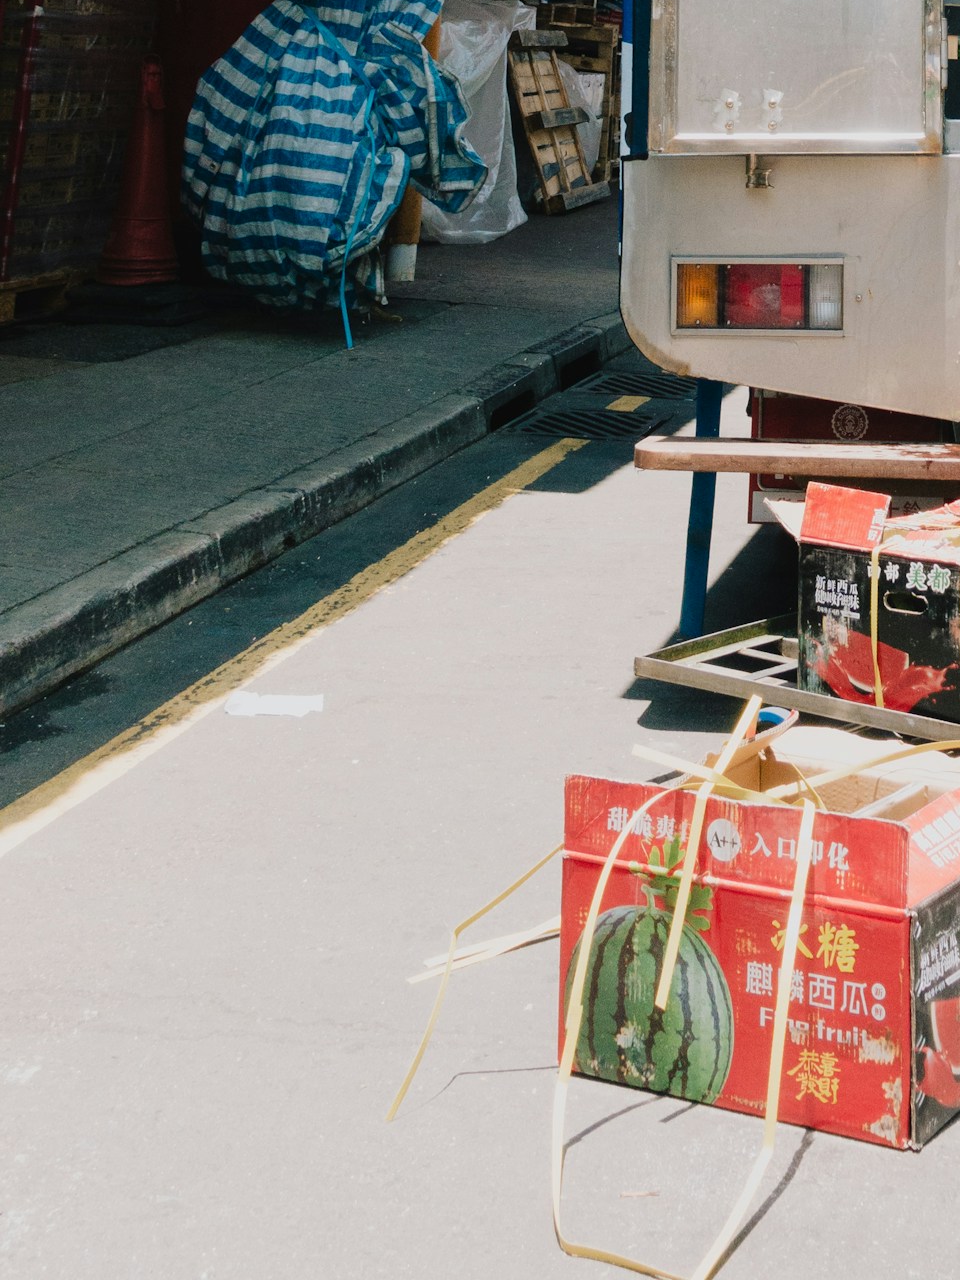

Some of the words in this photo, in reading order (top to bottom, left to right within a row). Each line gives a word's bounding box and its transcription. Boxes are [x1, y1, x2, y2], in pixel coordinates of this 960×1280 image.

[710, 831, 737, 848] A++
[771, 920, 859, 972] 冰糖
[759, 1006, 810, 1039] Fne
